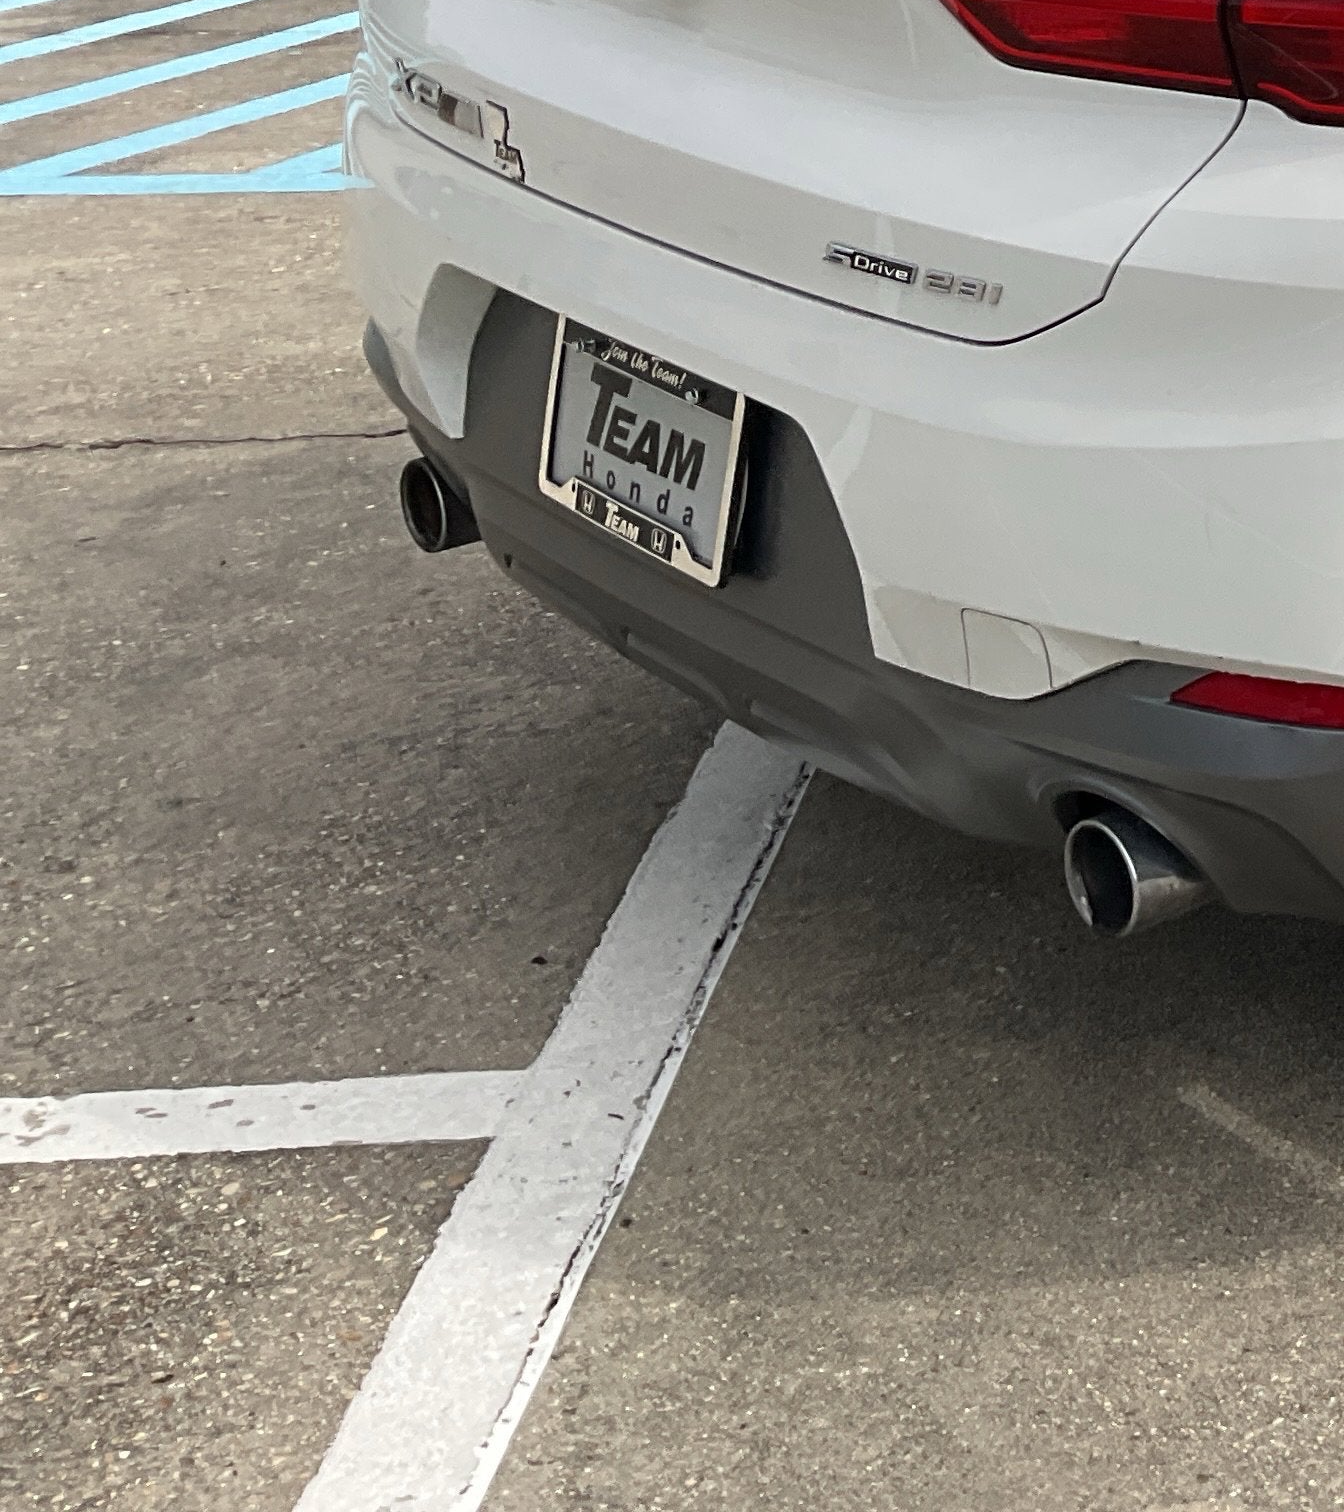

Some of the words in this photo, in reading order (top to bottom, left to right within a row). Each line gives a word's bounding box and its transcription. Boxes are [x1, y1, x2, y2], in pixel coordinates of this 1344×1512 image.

[600, 337, 629, 362] Join
[630, 351, 649, 372] the
[651, 355, 687, 389] Team!
[586, 361, 706, 491] TEAM
[582, 449, 695, 528] Honda
[604, 501, 641, 543] TEAM
